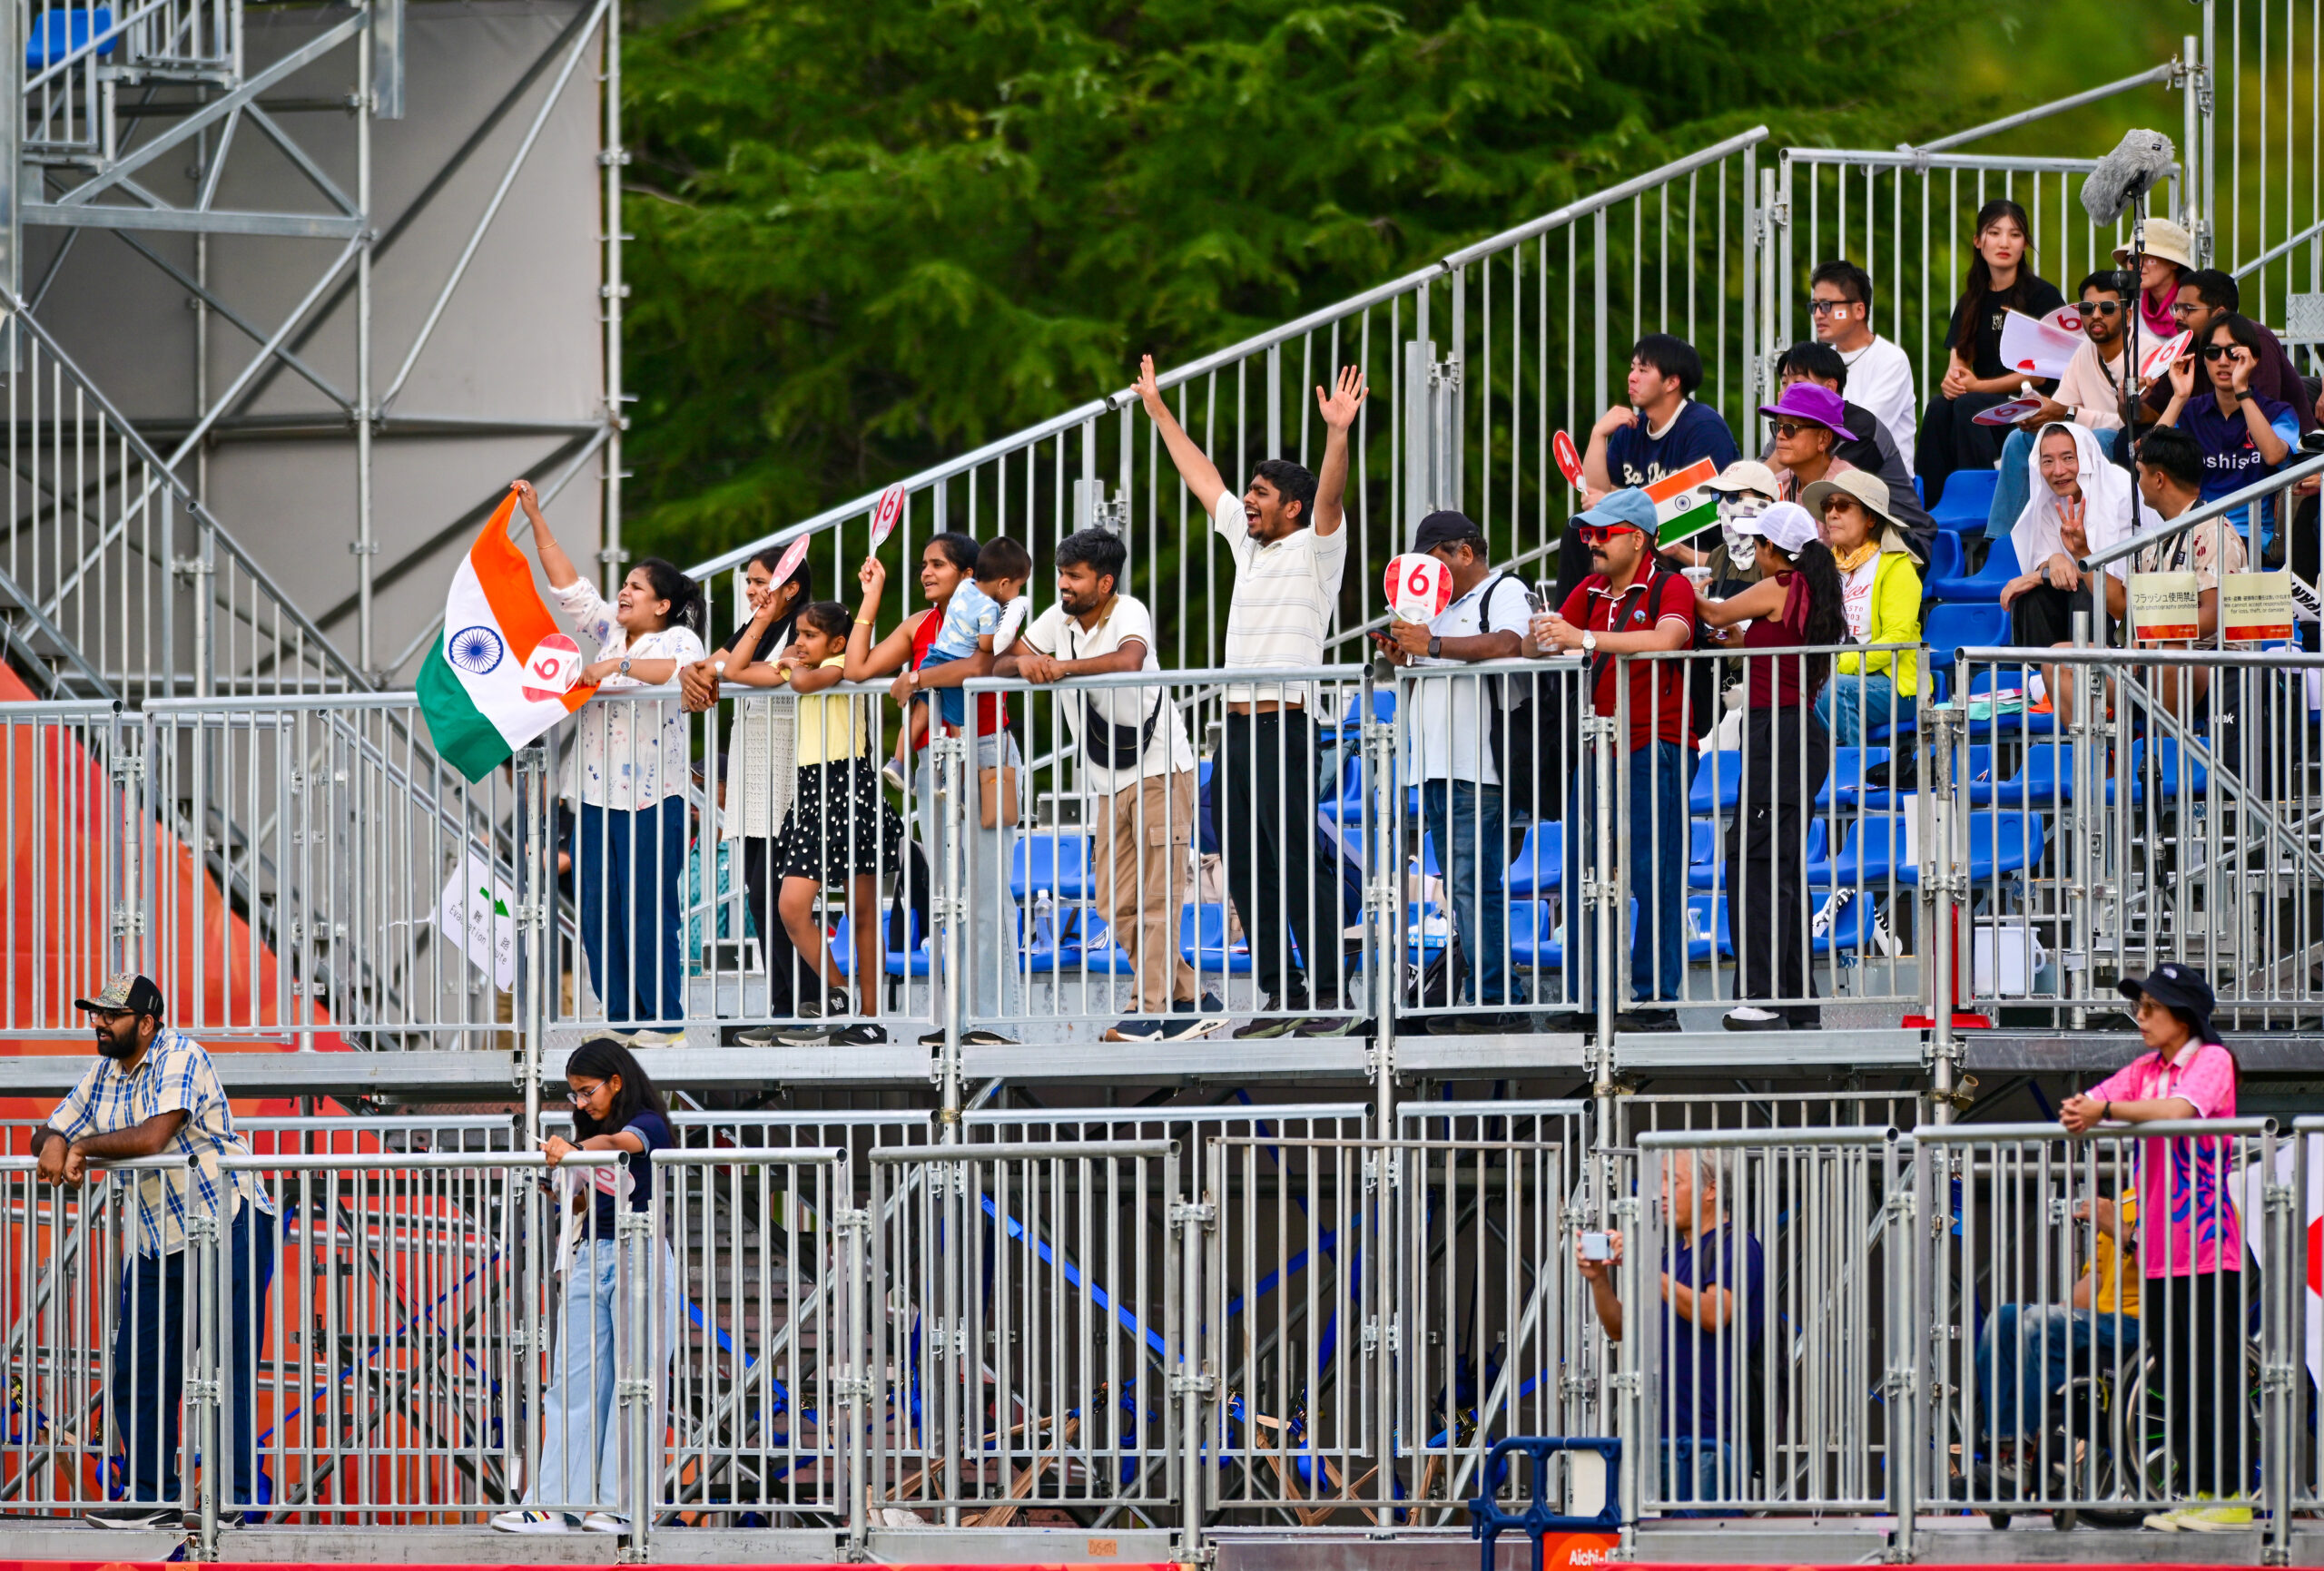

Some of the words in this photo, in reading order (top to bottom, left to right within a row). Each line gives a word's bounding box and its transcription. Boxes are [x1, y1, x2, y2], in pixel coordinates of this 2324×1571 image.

[2056, 313, 2083, 332] 6
[2159, 339, 2178, 363] 6
[1994, 407, 2019, 417] 6
[1559, 439, 1575, 468] 4
[882, 491, 897, 522] 6
[786, 541, 805, 570] 4
[1407, 564, 1430, 596] 6
[2133, 592, 2196, 604] フラッシュ使用禁止
[533, 658, 560, 681] 6
[448, 904, 487, 945] Evacation
[1569, 1548, 1609, 1566] Aichi-
